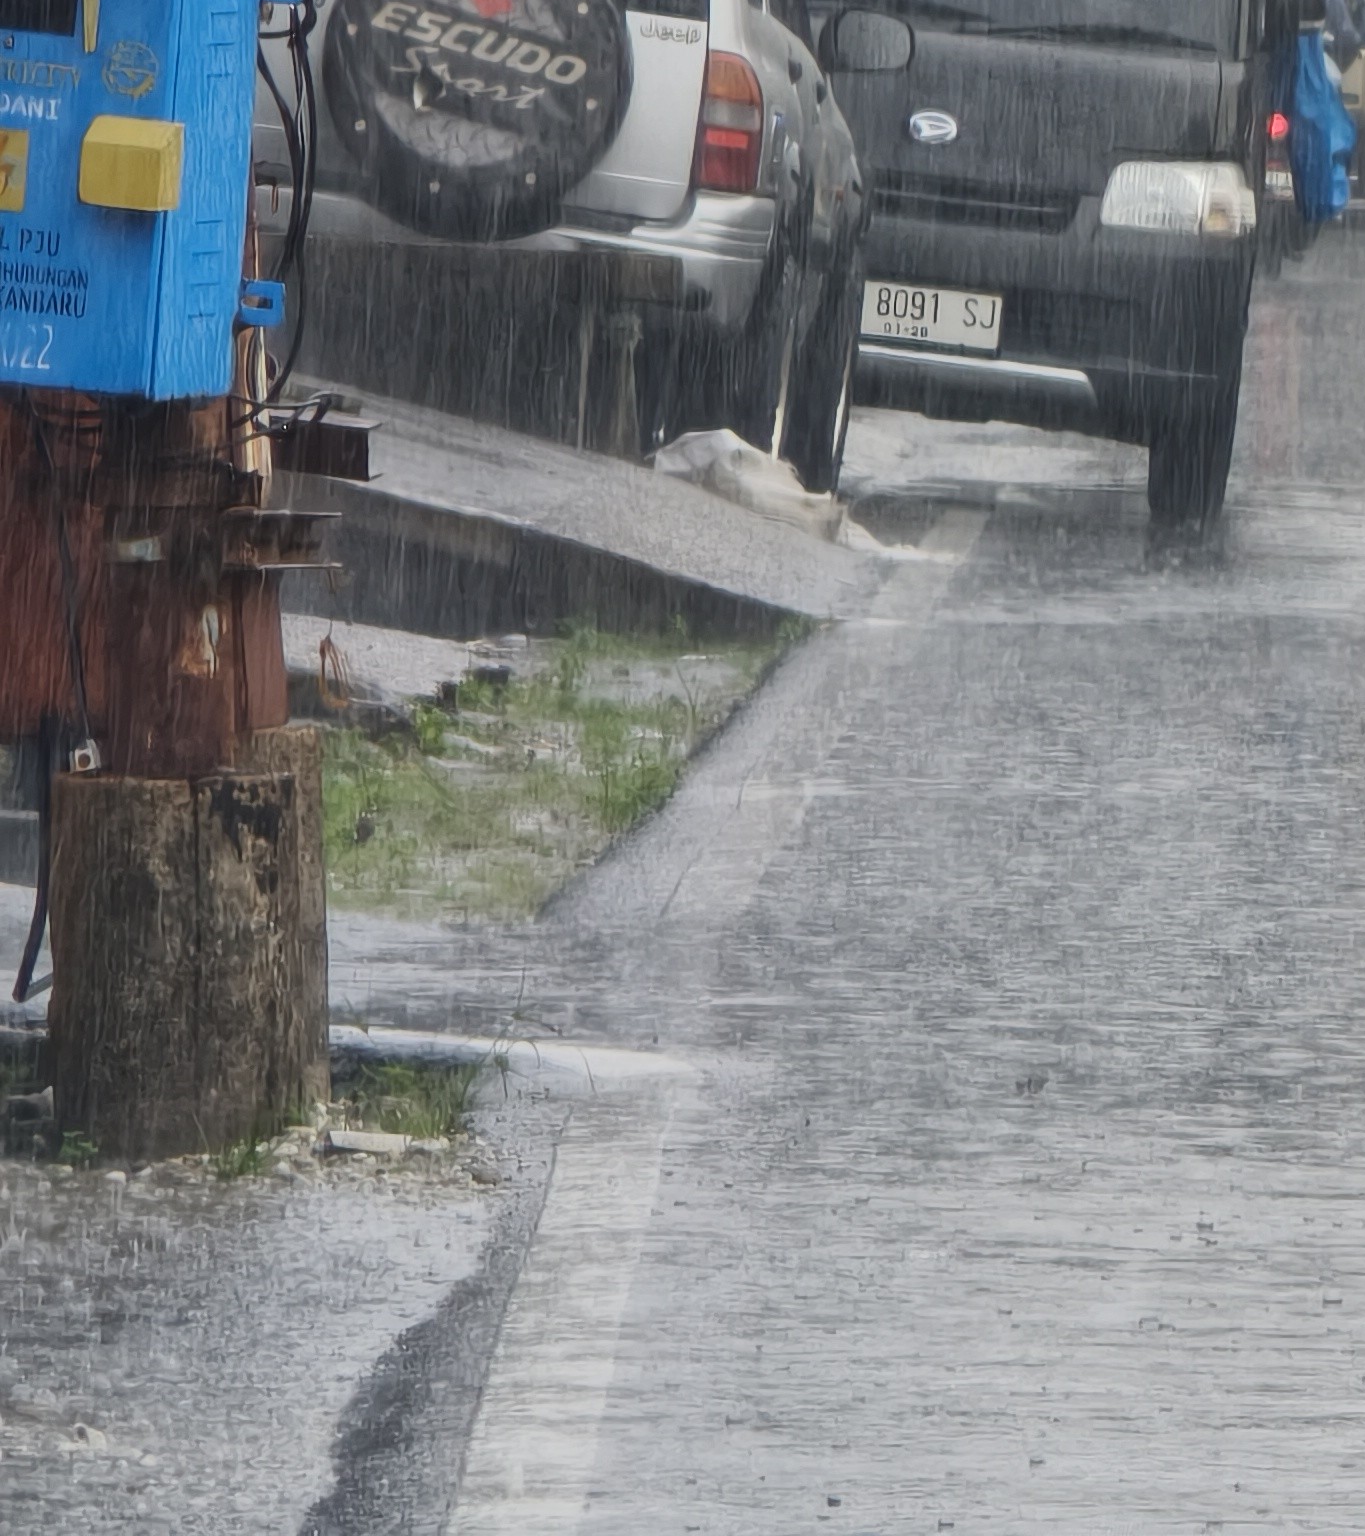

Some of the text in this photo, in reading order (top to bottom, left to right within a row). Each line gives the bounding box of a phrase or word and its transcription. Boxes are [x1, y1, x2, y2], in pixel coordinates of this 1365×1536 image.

[371, 1, 587, 85] ESCUDO
[19, 227, 61, 257] PJU
[876, 286, 997, 330] 8091 SJ
